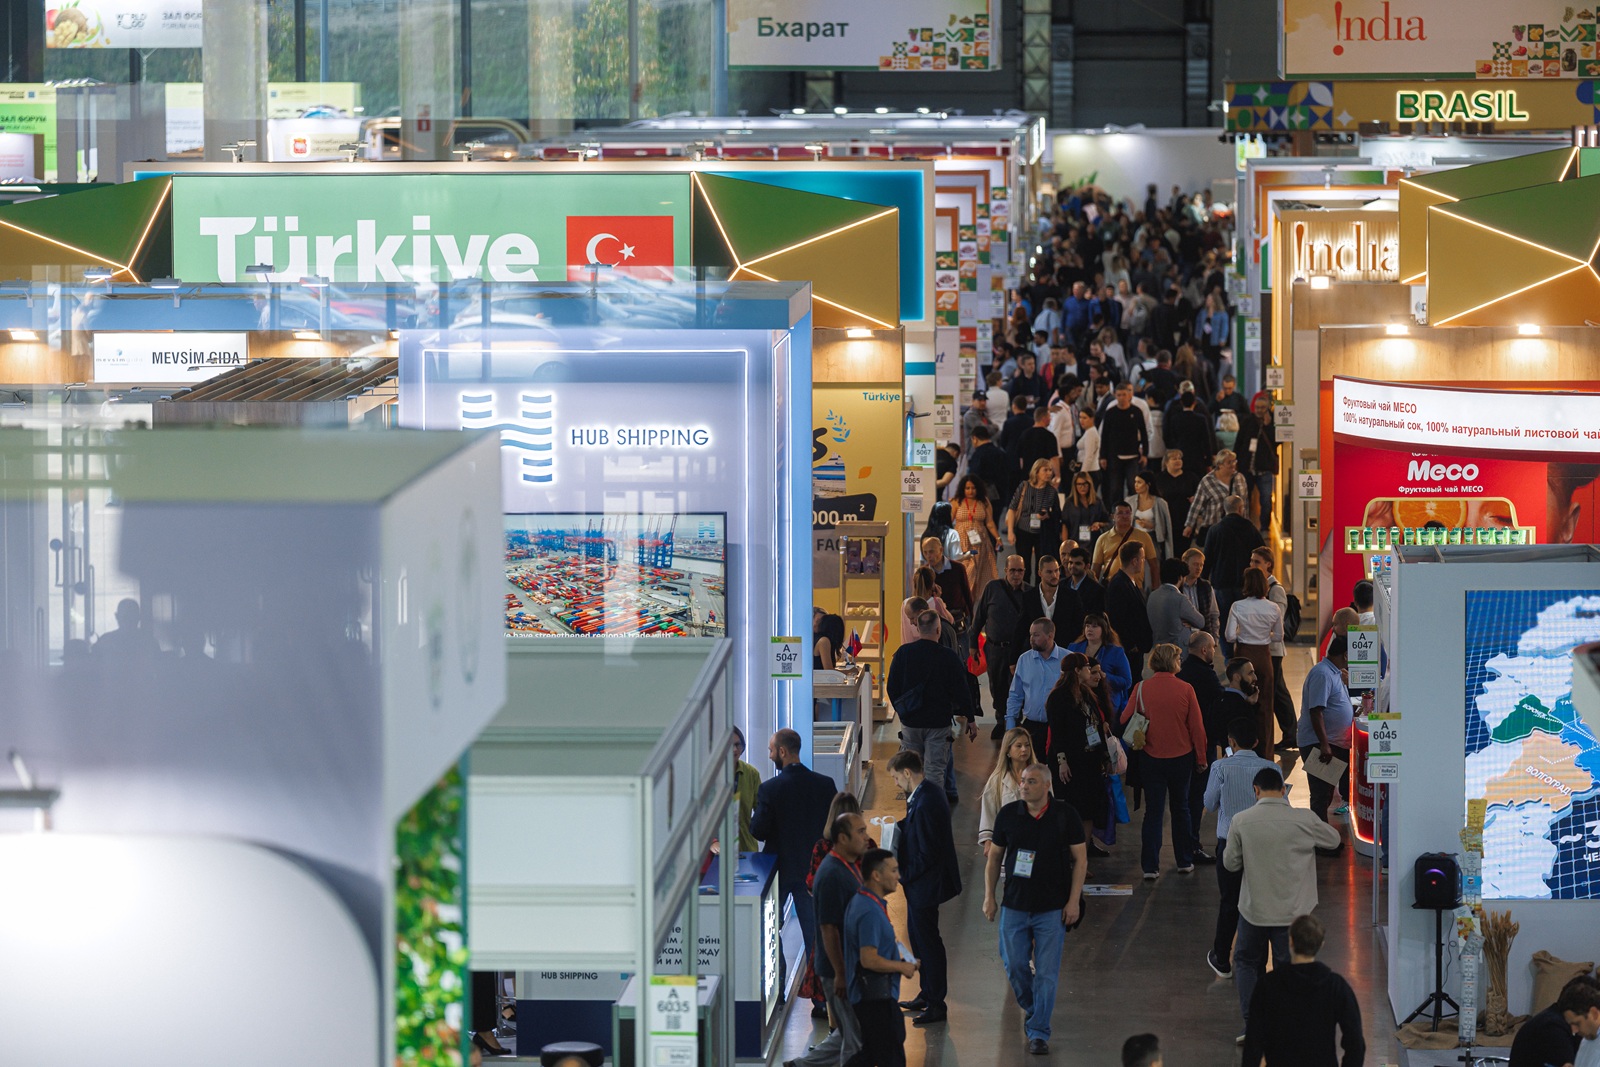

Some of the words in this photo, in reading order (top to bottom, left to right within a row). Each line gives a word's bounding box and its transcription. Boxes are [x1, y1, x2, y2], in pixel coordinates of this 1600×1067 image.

[184, 12, 202, 20] ФОР
[757, 16, 850, 42] Бхарат
[1396, 89, 1530, 122] BRASIL
[200, 215, 541, 283] Türkiye
[152, 349, 204, 364] MEVSİM
[209, 351, 240, 364] GIDA
[862, 392, 900, 403] Türkiye
[1343, 396, 1377, 410] Фруктовый
[1378, 402, 1391, 411] чай
[1343, 412, 1357, 424] 100%
[1358, 416, 1405, 429] натуральный
[1407, 421, 1424, 432] сок,
[1426, 421, 1449, 433] 100%
[1451, 425, 1520, 438] натуральный
[1524, 428, 1579, 439] листовой
[572, 429, 609, 445] HUB
[616, 429, 709, 446] SHIPPING
[1398, 486, 1442, 494] Фруктовый
[783, 644, 790, 652] A
[1352, 641, 1373, 649] 6047
[776, 653, 797, 661] 5047
[1381, 721, 1389, 730] A
[1373, 731, 1397, 739] 6045
[1525, 765, 1572, 796] ВОЛГОГРАД
[541, 971, 558, 980] HUB
[559, 971, 598, 980] SHIPPING
[668, 988, 678, 999] A
